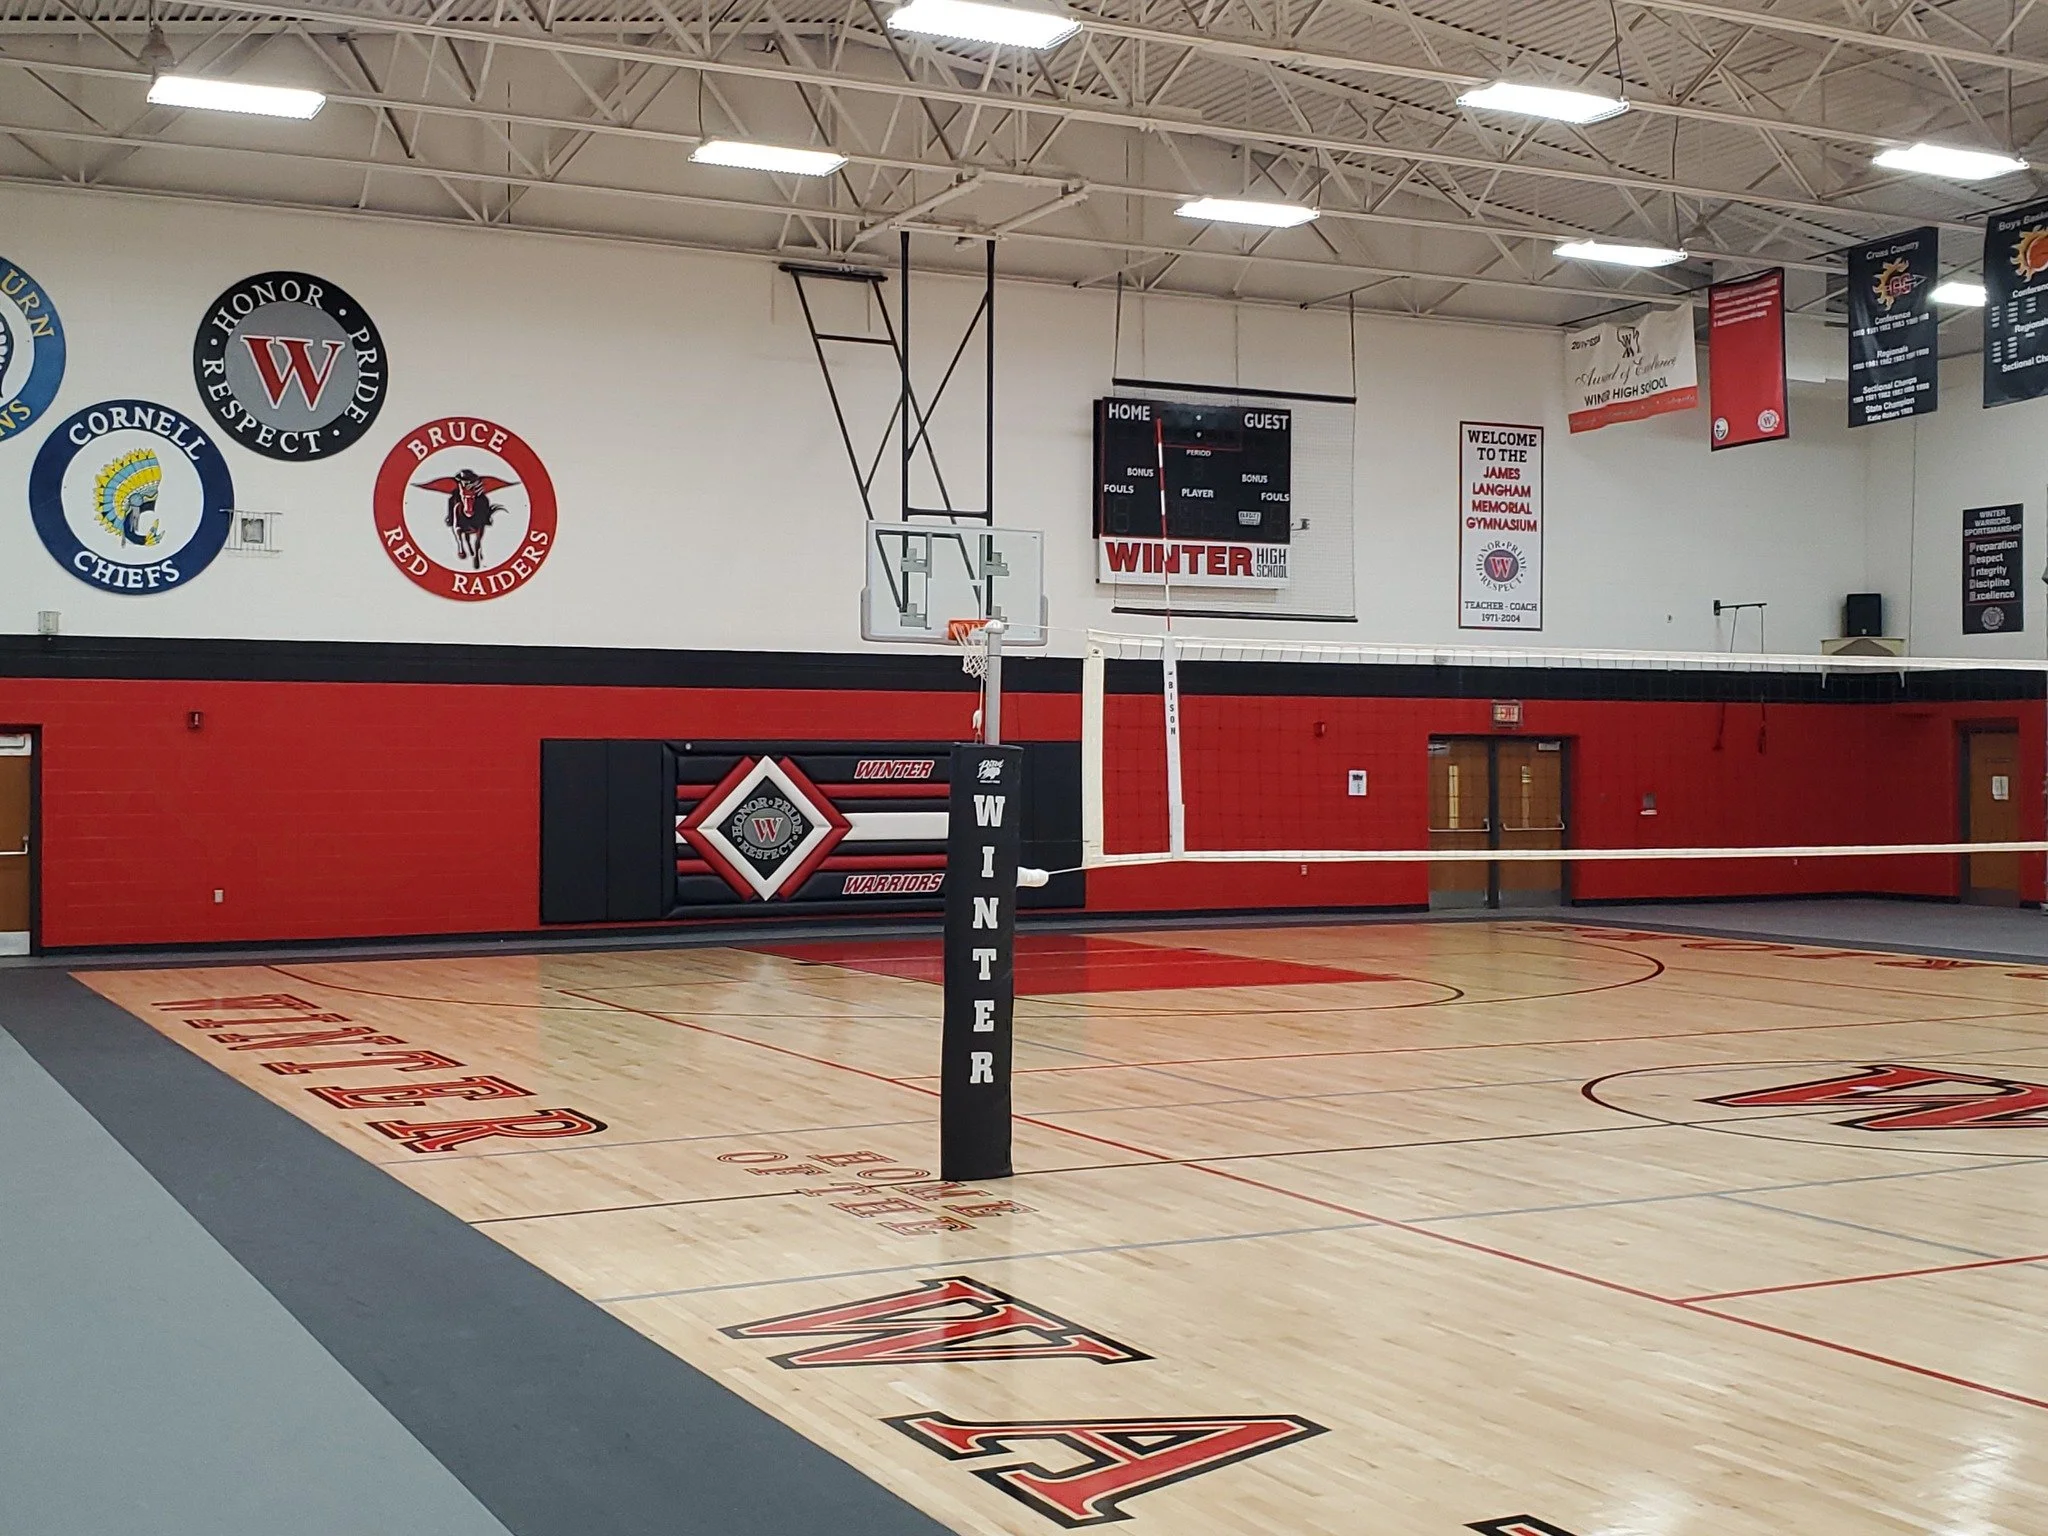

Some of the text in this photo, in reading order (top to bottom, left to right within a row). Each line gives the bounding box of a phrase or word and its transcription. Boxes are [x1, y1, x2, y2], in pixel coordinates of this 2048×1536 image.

[1866, 241, 1919, 260] Cross Country
[202, 280, 379, 453] HONOR PRIDE RESPECT
[2002, 356, 2034, 373] Sectional
[240, 335, 345, 411] W
[1612, 385, 1639, 400] HIGH
[1863, 381, 1893, 394] Sectional
[1108, 403, 1150, 421] HOME
[1865, 404, 1882, 413] State
[1244, 413, 1289, 430] GUEST
[69, 407, 206, 461] CORNELL
[407, 421, 508, 461] BRUCE
[1467, 429, 1537, 447] WELCOME
[1186, 449, 1211, 457] PERIOD
[1476, 447, 1527, 463] TO THE
[1127, 467, 1154, 477] BONUS
[1241, 474, 1268, 483] BONUS
[1483, 466, 1520, 480] JAMES
[1104, 484, 1134, 494] FOULS
[1181, 488, 1214, 499] PLAYER
[1261, 492, 1289, 502] FOULS
[1472, 482, 1531, 498] LANGHAM
[1472, 500, 1532, 515] MEMORIAL
[1979, 509, 2006, 518] WINTER
[1466, 517, 1537, 532] GYMNASIUM
[1964, 524, 2021, 536] SPORTSMANSHIP
[1969, 540, 2018, 553] Preparation
[383, 526, 548, 595] RED RAIDERS
[1104, 541, 1255, 576] WINTER
[1257, 548, 1286, 565] HIGH
[1969, 553, 2004, 565] Respect
[74, 551, 180, 589] CHIEFS
[1256, 564, 1288, 579] SCHOOL
[1476, 541, 1526, 592] HONOR PRIDE RESPECT
[1489, 556, 1513, 578] W
[1969, 578, 2010, 589] Discipline
[1969, 590, 2015, 601] Excellence
[1465, 600, 1504, 611] TEACHER
[1510, 602, 1537, 611] COACH
[1481, 613, 1520, 623] 1971-2004
[1168, 681, 1176, 735] BISON
[854, 760, 935, 779] WINTER
[732, 797, 803, 860] HONOR PRIDE RESPECT
[752, 817, 783, 842] W
[842, 873, 945, 895] WARRIORS
[969, 795, 1005, 1084] WINTER
[151, 993, 609, 1154] WINTER
